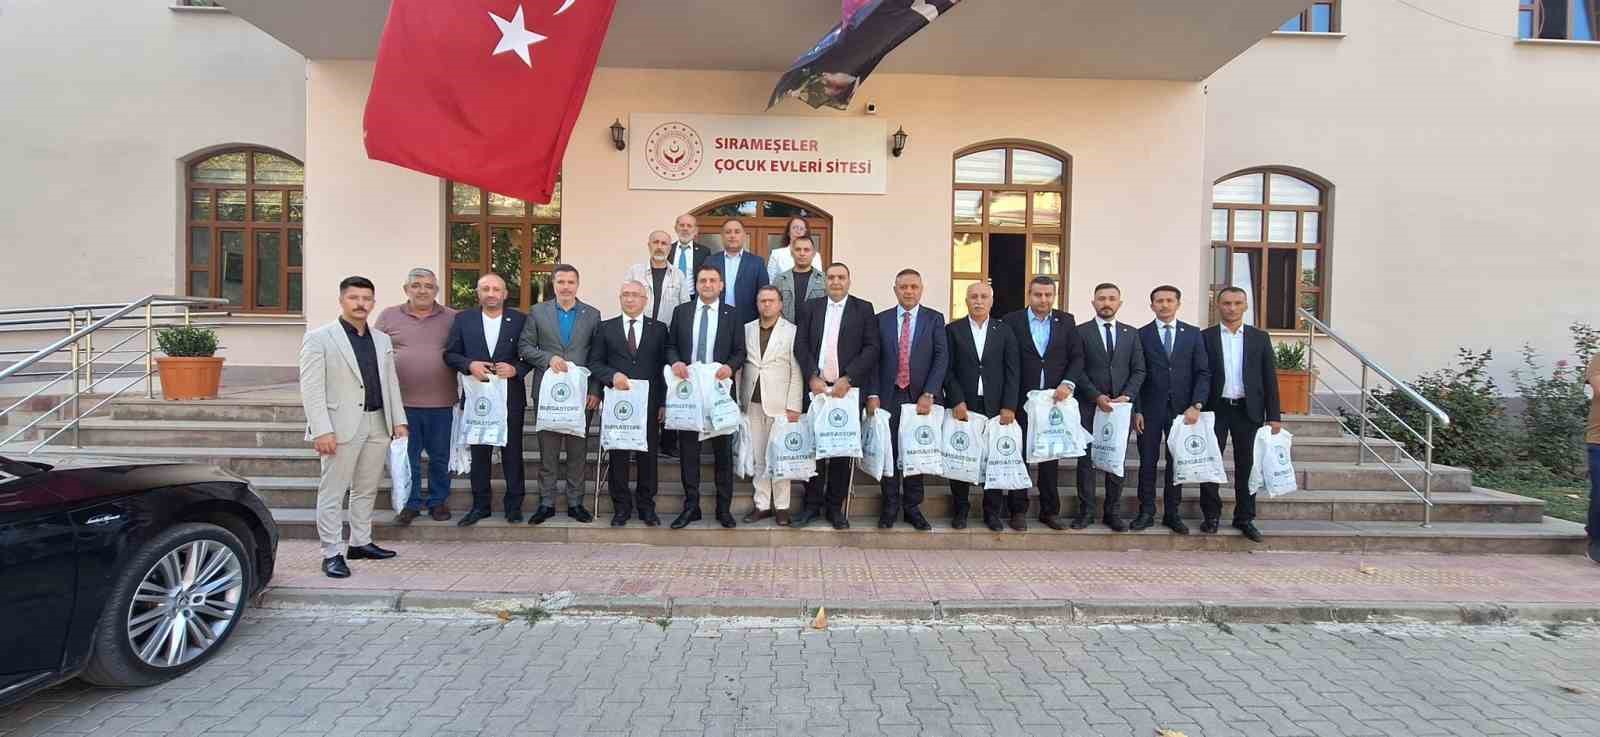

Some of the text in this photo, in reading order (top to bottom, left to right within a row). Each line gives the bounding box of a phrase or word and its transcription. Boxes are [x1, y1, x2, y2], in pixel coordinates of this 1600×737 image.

[715, 137, 819, 153] SIRAMEŞELER
[714, 158, 872, 174] ÇOCUK EVLERİ SİTESİ
